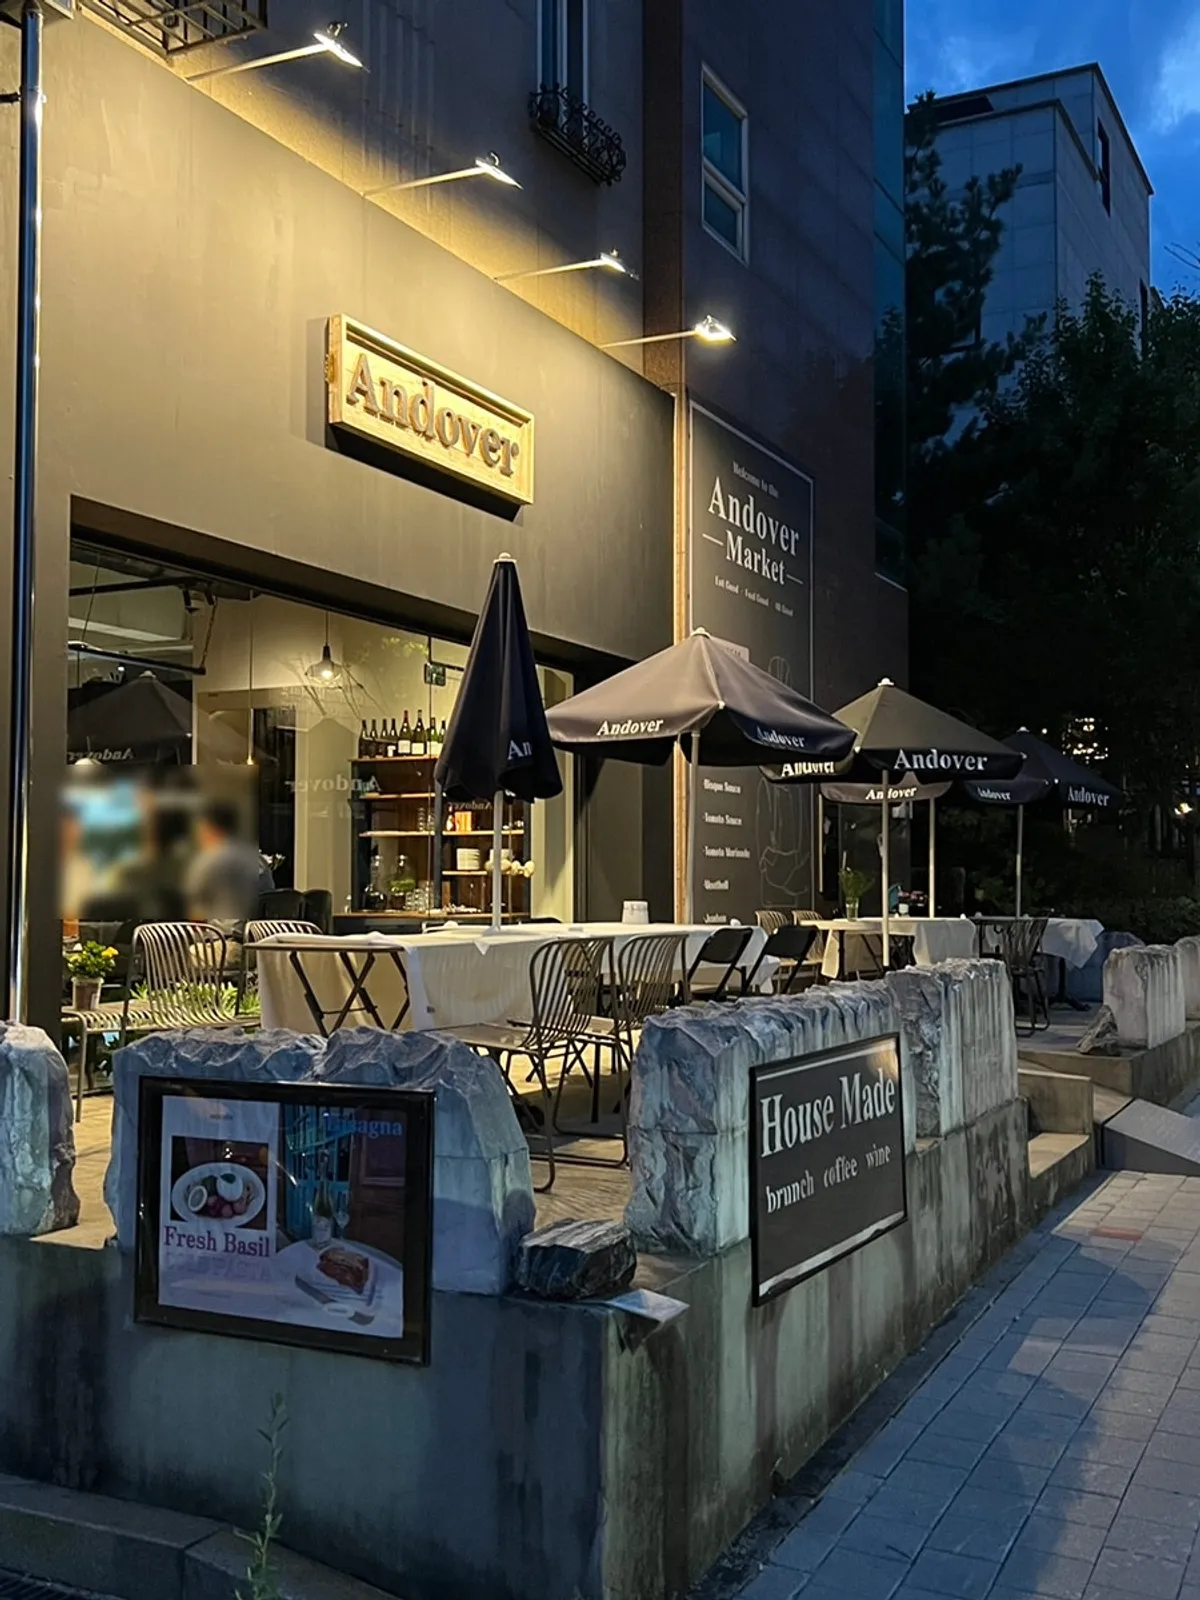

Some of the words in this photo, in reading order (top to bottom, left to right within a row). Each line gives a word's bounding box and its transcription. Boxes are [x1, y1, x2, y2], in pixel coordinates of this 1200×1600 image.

[346, 353, 520, 477] Andover
[732, 460, 760, 488] Welcome
[708, 476, 799, 557] Andover
[726, 530, 785, 585] Market
[596, 719, 664, 736] Andover
[757, 725, 805, 748] Andover
[894, 748, 988, 771] Andover
[1068, 785, 1110, 806] Andover
[705, 812, 725, 824] Tomato
[705, 845, 725, 857] Tomato
[760, 1093, 834, 1158] House
[839, 1067, 896, 1129] Made
[326, 1115, 403, 1139] agna
[766, 1169, 815, 1213] brunch
[823, 1154, 858, 1188] coffee
[866, 1143, 891, 1169] wine
[164, 1225, 217, 1252] Fresh
[223, 1231, 270, 1258] Basil
